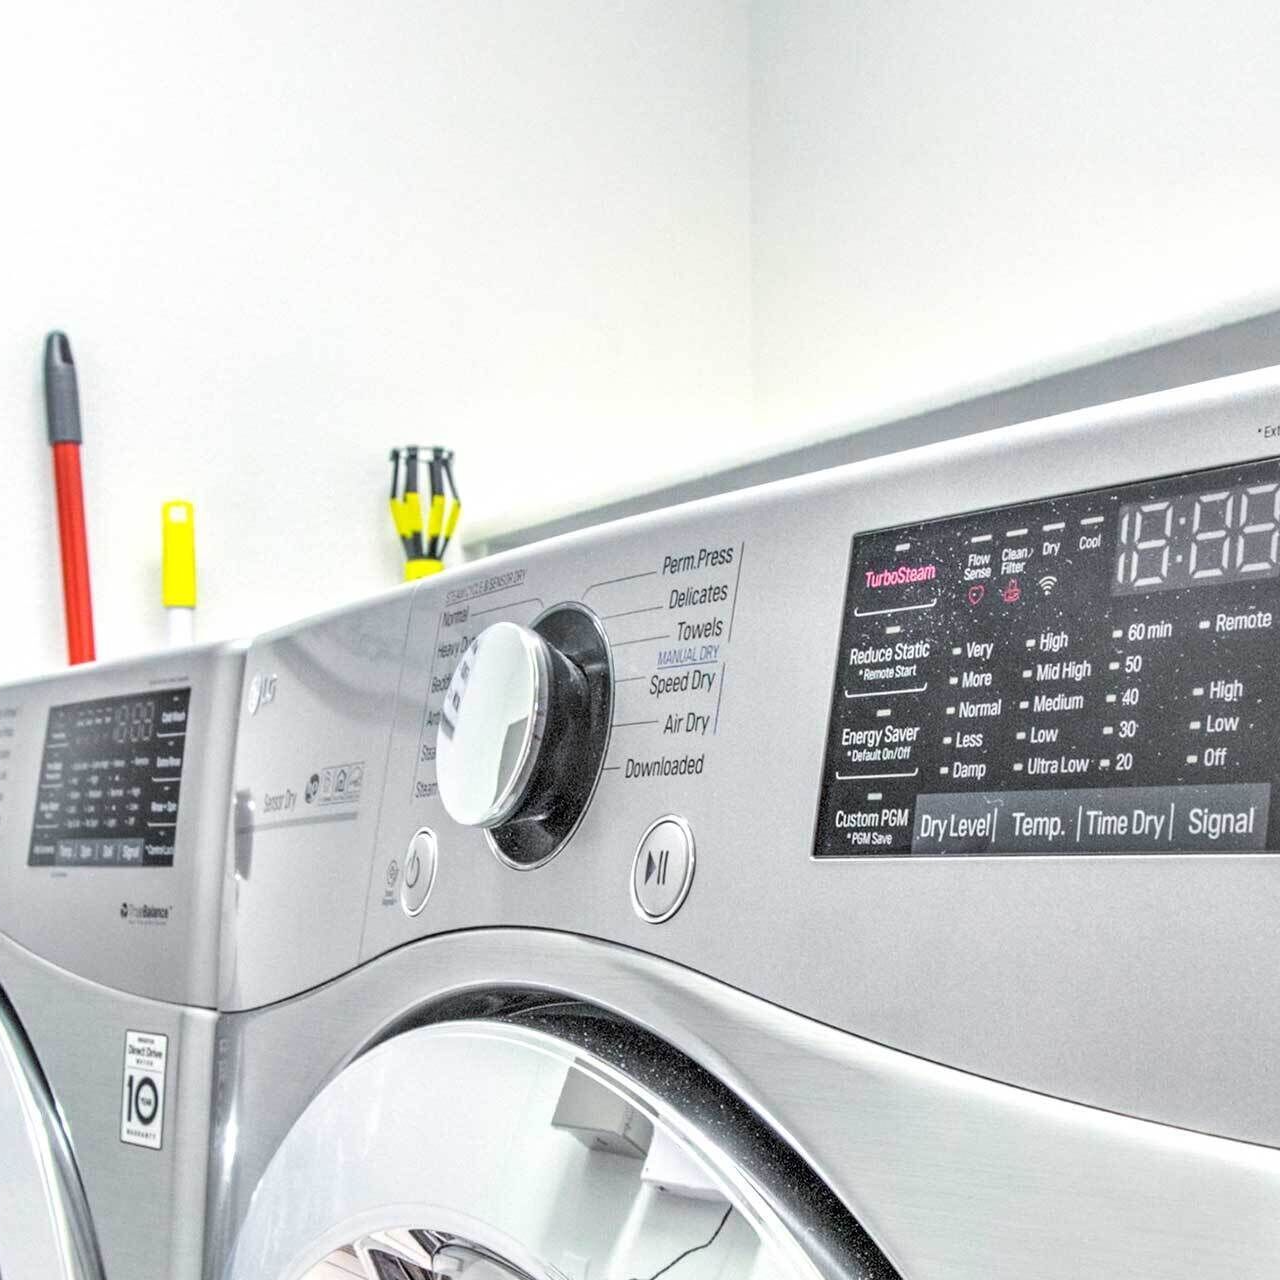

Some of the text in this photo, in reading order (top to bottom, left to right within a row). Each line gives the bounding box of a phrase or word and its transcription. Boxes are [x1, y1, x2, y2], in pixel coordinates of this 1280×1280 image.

[1042, 542, 1061, 556] Dry
[1079, 534, 1101, 550] Cool
[967, 553, 991, 567] Flow
[1001, 548, 1028, 562] Clean
[865, 564, 937, 588] TurboSteam
[964, 567, 992, 581] Sense
[1000, 561, 1026, 575] Filter
[668, 584, 728, 609] Delicates
[677, 616, 724, 641] Towels
[1128, 620, 1172, 641] 60 min
[1215, 611, 1272, 632] Remote
[966, 641, 994, 659] Very
[1039, 632, 1069, 652] High
[657, 644, 720, 666] MANUAL DRY
[849, 641, 931, 665] Reduce Static
[863, 664, 917, 681] Remote Start
[1036, 660, 1092, 681] Mid High
[1125, 655, 1142, 673] 50
[649, 669, 717, 699] Speed Dry
[961, 671, 992, 688] More
[1122, 688, 1139, 706] 40
[1209, 680, 1243, 701] High
[958, 699, 1002, 718] Normal
[1033, 694, 1084, 712] Medium
[663, 712, 711, 736] Air Dry
[1119, 720, 1136, 738] 30
[1206, 714, 1240, 732] Low
[841, 725, 920, 747] Energy Saver
[955, 732, 984, 748] Less
[1030, 727, 1059, 743] Low
[851, 746, 911, 762] Default On/Off
[1115, 753, 1133, 771] 20
[1203, 748, 1227, 767] Off
[625, 753, 705, 779] Downloaded
[952, 762, 987, 780] Damp
[1027, 756, 1089, 775] Ultra Low
[835, 808, 909, 828] Custom PGM
[920, 812, 992, 843] Dry Level
[1013, 812, 1066, 841] Temp.
[1086, 810, 1166, 840] Time Dry
[1188, 807, 1256, 840] Signal
[851, 832, 893, 845] PGM Save
[127, 1074, 159, 1126] 10
